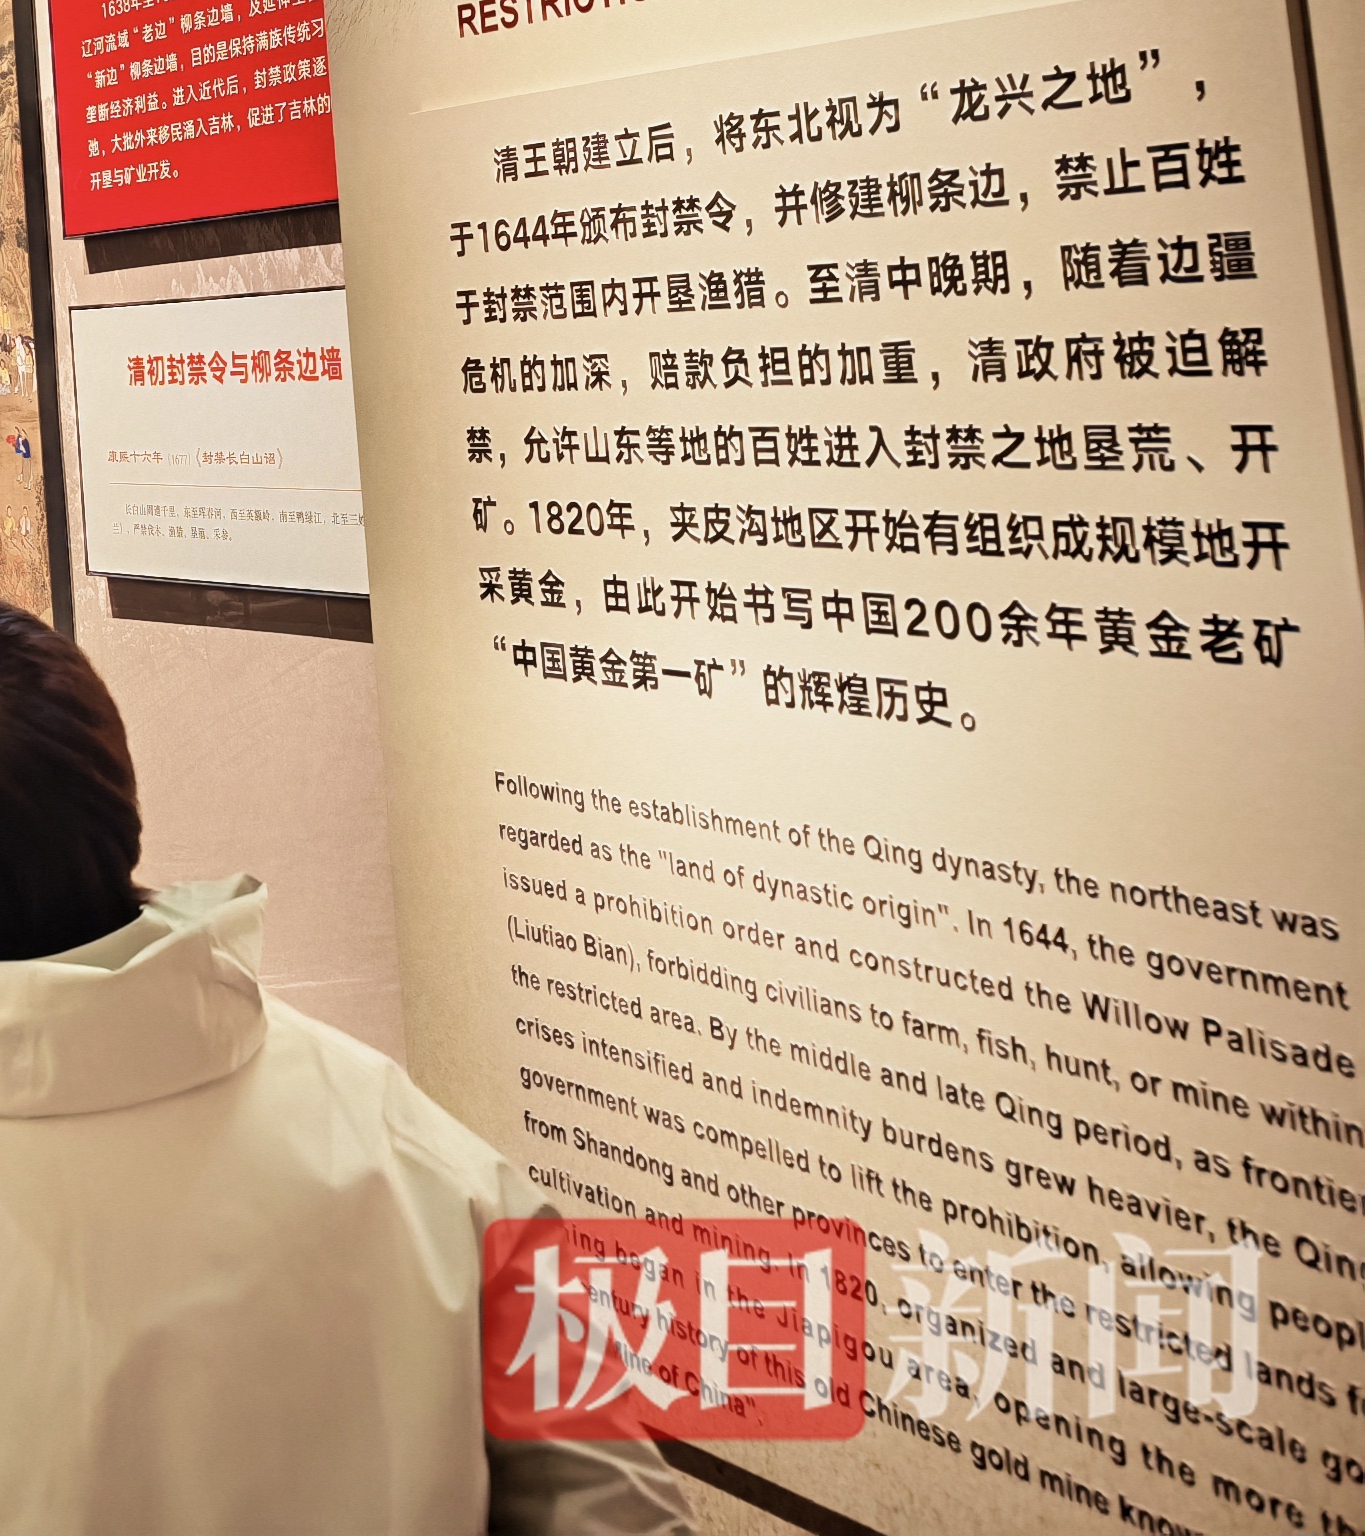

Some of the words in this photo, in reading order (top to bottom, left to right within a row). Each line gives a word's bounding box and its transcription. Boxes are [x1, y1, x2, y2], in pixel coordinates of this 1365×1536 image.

[127, 346, 343, 387] 清初封禁令与柳条边墙
[494, 770, 585, 813] Following
[591, 788, 622, 814] the
[629, 799, 781, 843] establishment
[788, 824, 811, 848] of
[818, 827, 856, 856] the
[864, 834, 923, 874] Qing
[932, 847, 1045, 894] dynasty,
[1054, 867, 1100, 899] the
[1111, 881, 1263, 928] northeast
[1270, 907, 1340, 942] was
[499, 823, 583, 856] regarded
[590, 841, 613, 862] as
[619, 843, 651, 869] the
[658, 850, 715, 883] "land
[723, 865, 745, 889] of
[752, 870, 854, 911] dynastic
[967, 909, 993, 940] In
[1003, 916, 1078, 961] 1644,
[1087, 933, 1136, 966] the
[1146, 949, 1351, 1011] government
[503, 867, 567, 902] issued
[575, 887, 586, 906] a
[594, 891, 714, 936] prohibition
[723, 919, 785, 951] order
[795, 936, 840, 963] and
[850, 948, 1014, 1001] constructed
[1025, 980, 1072, 1014] the
[1082, 989, 1190, 1041] Willow
[1202, 1015, 1356, 1078] Palisade
[507, 914, 577, 952] (Liutiao
[583, 933, 640, 972] Bian),
[647, 949, 758, 1004] forbidding
[765, 980, 862, 1024] civilians
[870, 1004, 894, 1031] to
[902, 1010, 968, 1055] farm,
[976, 1027, 1037, 1072] fish,
[1045, 1043, 1120, 1092] hunt,
[1130, 1069, 1162, 1097] or
[1172, 1078, 1251, 1119] mine
[1259, 1099, 1365, 1149] within
[511, 963, 541, 991] the
[547, 976, 643, 1020] restricted
[650, 1004, 703, 1036] area.
[710, 1015, 738, 1050] By
[746, 1026, 782, 1057] the
[790, 1041, 872, 1082] middle
[880, 1065, 928, 1097] and
[936, 1074, 986, 1112] late
[995, 1091, 1063, 1139] Qing
[1074, 1115, 1182, 1171] period,
[1193, 1146, 1231, 1179] as
[516, 1016, 575, 1050] crises
[582, 1030, 694, 1085] intensified
[702, 1070, 743, 1100] and
[752, 1079, 872, 1143] indemnity
[882, 1116, 994, 1173] burdens
[1005, 1158, 1076, 1196] grew
[1087, 1174, 1215, 1243] heavier,
[1227, 1216, 1281, 1259] the
[520, 1066, 639, 1119] government
[643, 1104, 686, 1134] was
[693, 1119, 810, 1174] compelled
[818, 1155, 842, 1183] to
[850, 1163, 886, 1198] lift
[892, 1176, 933, 1212] the
[942, 1196, 1109, 1273] prohibition,
[1120, 1252, 1258, 1323] allowing
[524, 1110, 568, 1145] from
[573, 1126, 674, 1186] Shandong
[681, 1166, 720, 1198] and
[726, 1181, 786, 1219] other
[792, 1204, 911, 1262] provinces
[919, 1243, 944, 1274] to
[953, 1257, 1023, 1298] enter
[1031, 1280, 1076, 1318] the
[1085, 1301, 1233, 1373] restricted
[1243, 1349, 1337, 1407] lands
[528, 1164, 637, 1220] cultivation
[645, 1205, 684, 1236] and
[897, 1297, 1038, 1366] organized
[1050, 1351, 1106, 1391] and
[1116, 1366, 1308, 1464] large-scale
[581, 1280, 650, 1329] entury
[655, 1306, 730, 1363] history
[736, 1345, 758, 1368] of
[764, 1353, 806, 1389] this
[814, 1376, 852, 1409] old
[859, 1390, 962, 1454] Chinese
[970, 1438, 1031, 1483] gold
[1038, 1465, 1110, 1516] mine
[614, 1240, 685, 1290] began
[695, 1270, 716, 1300] in
[727, 1281, 765, 1320] the
[776, 1302, 894, 1369] Jiapigou
[993, 1391, 1127, 1468] opening
[1141, 1442, 1196, 1487] the
[1211, 1472, 1305, 1529] more
[659, 1364, 678, 1385] of
